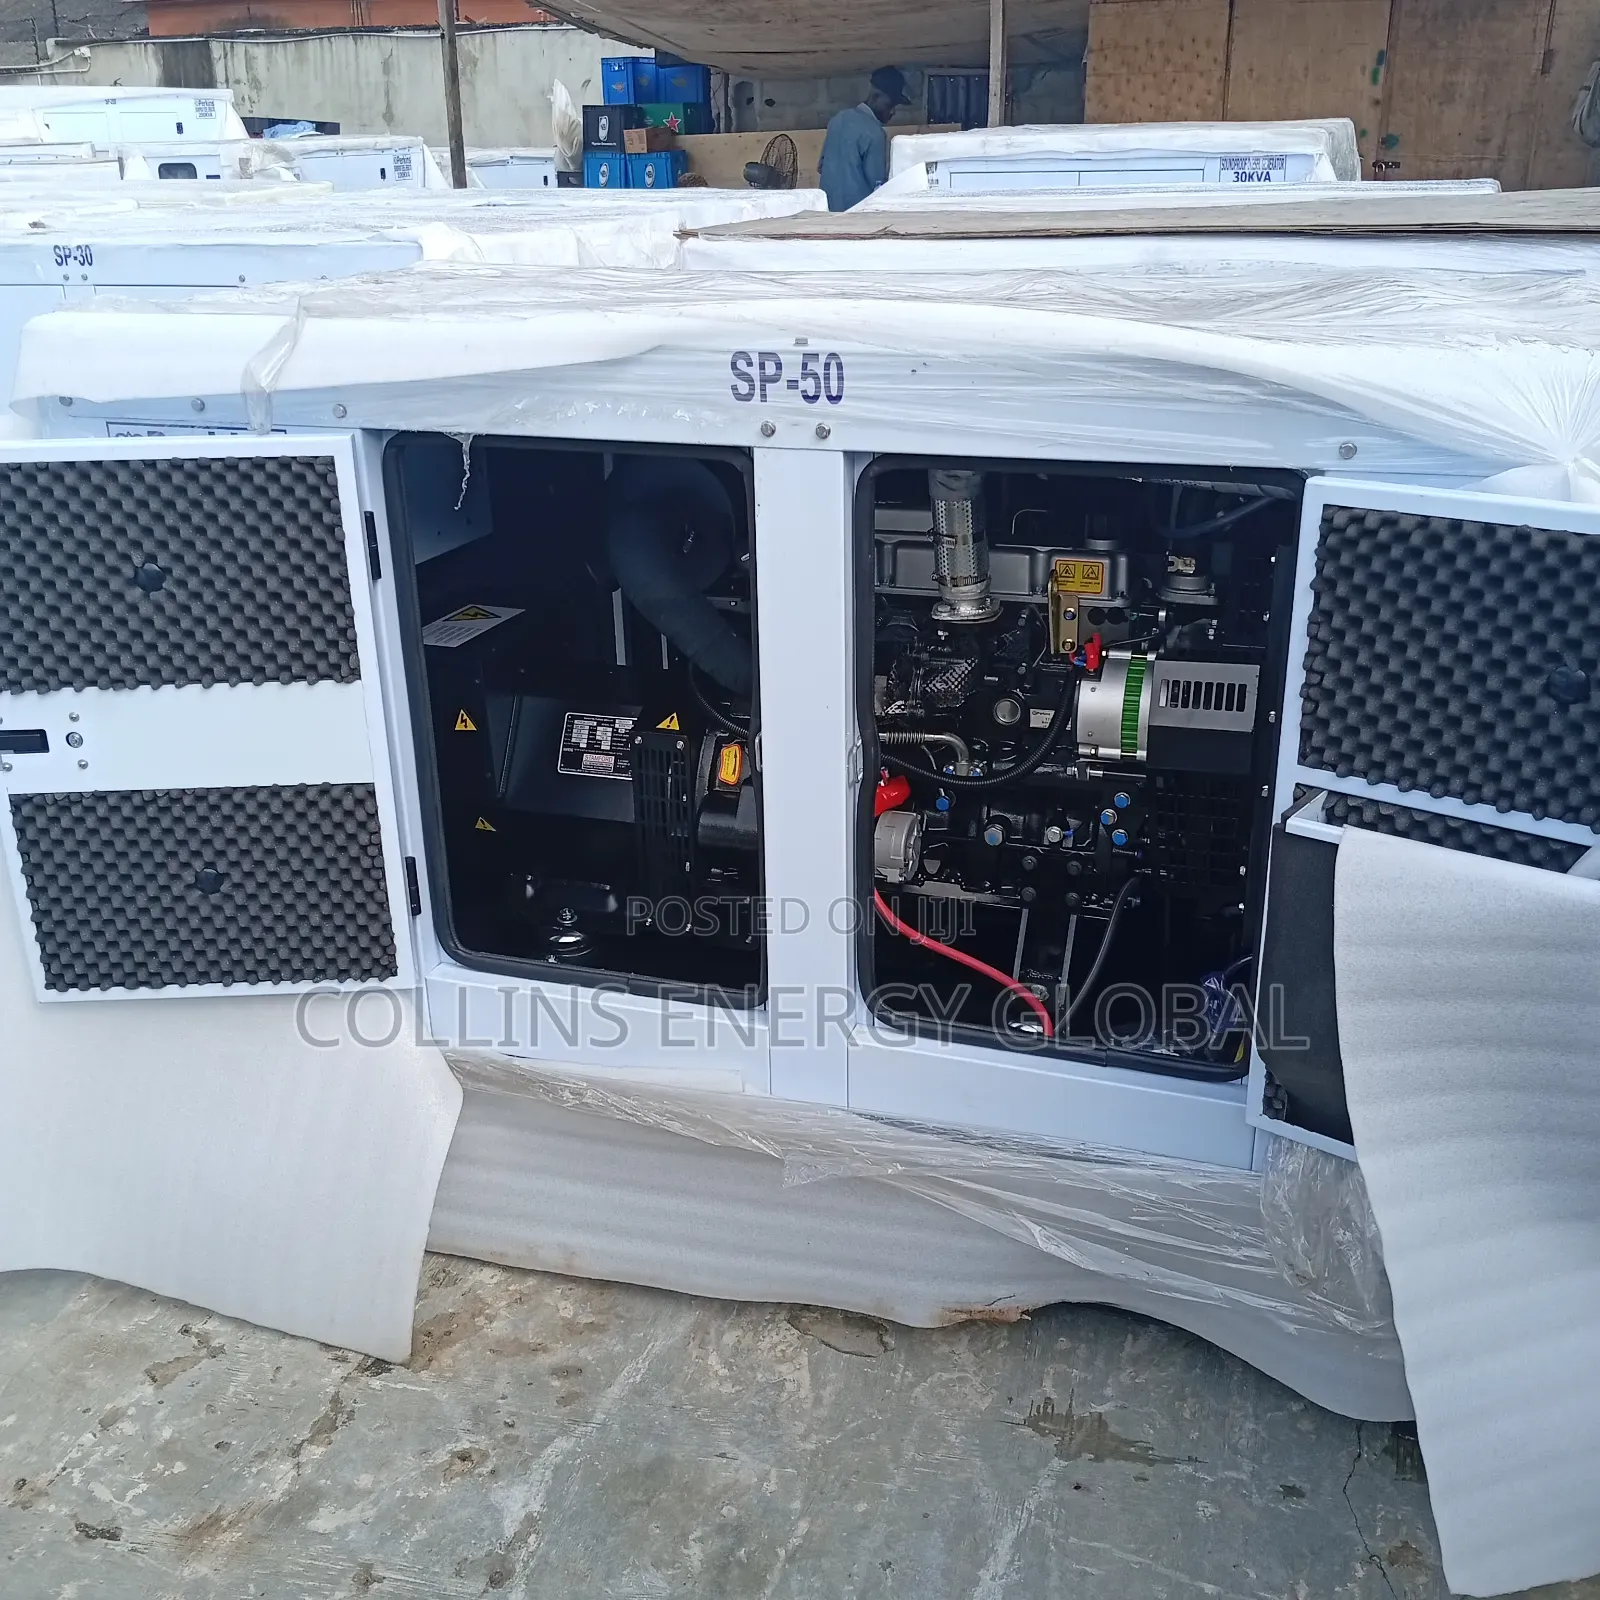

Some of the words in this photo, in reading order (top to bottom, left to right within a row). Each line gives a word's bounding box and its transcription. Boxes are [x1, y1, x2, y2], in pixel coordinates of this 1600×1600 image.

[1232, 171, 1272, 182] 30KVA
[53, 244, 93, 267] SP-30
[730, 350, 845, 405] SP-50
